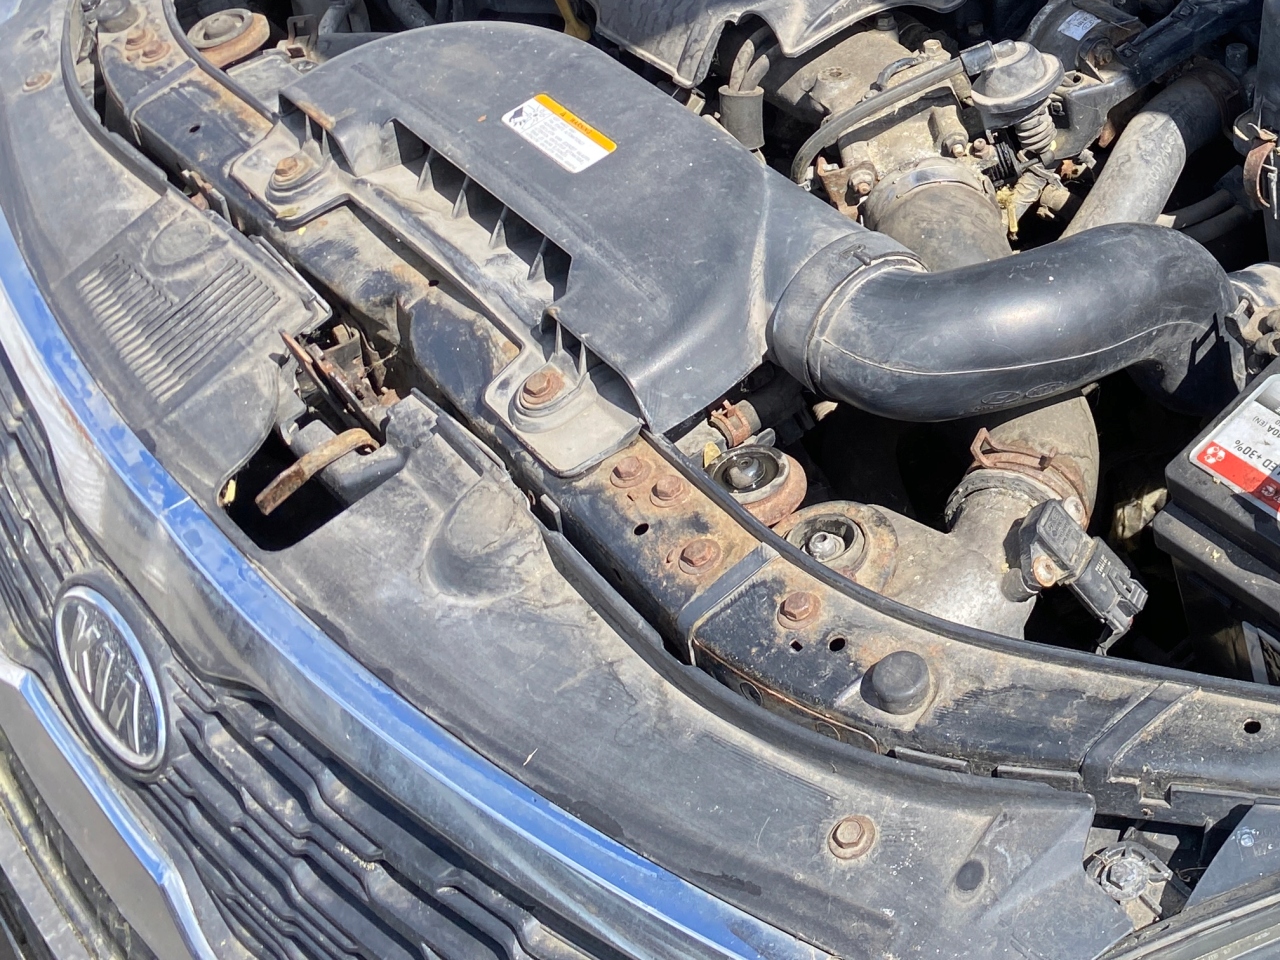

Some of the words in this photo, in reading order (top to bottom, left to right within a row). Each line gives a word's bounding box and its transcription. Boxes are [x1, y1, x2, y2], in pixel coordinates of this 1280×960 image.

[1253, 415, 1269, 428] (EN)
[1234, 439, 1263, 461] +30%
[68, 603, 141, 755] KIA
